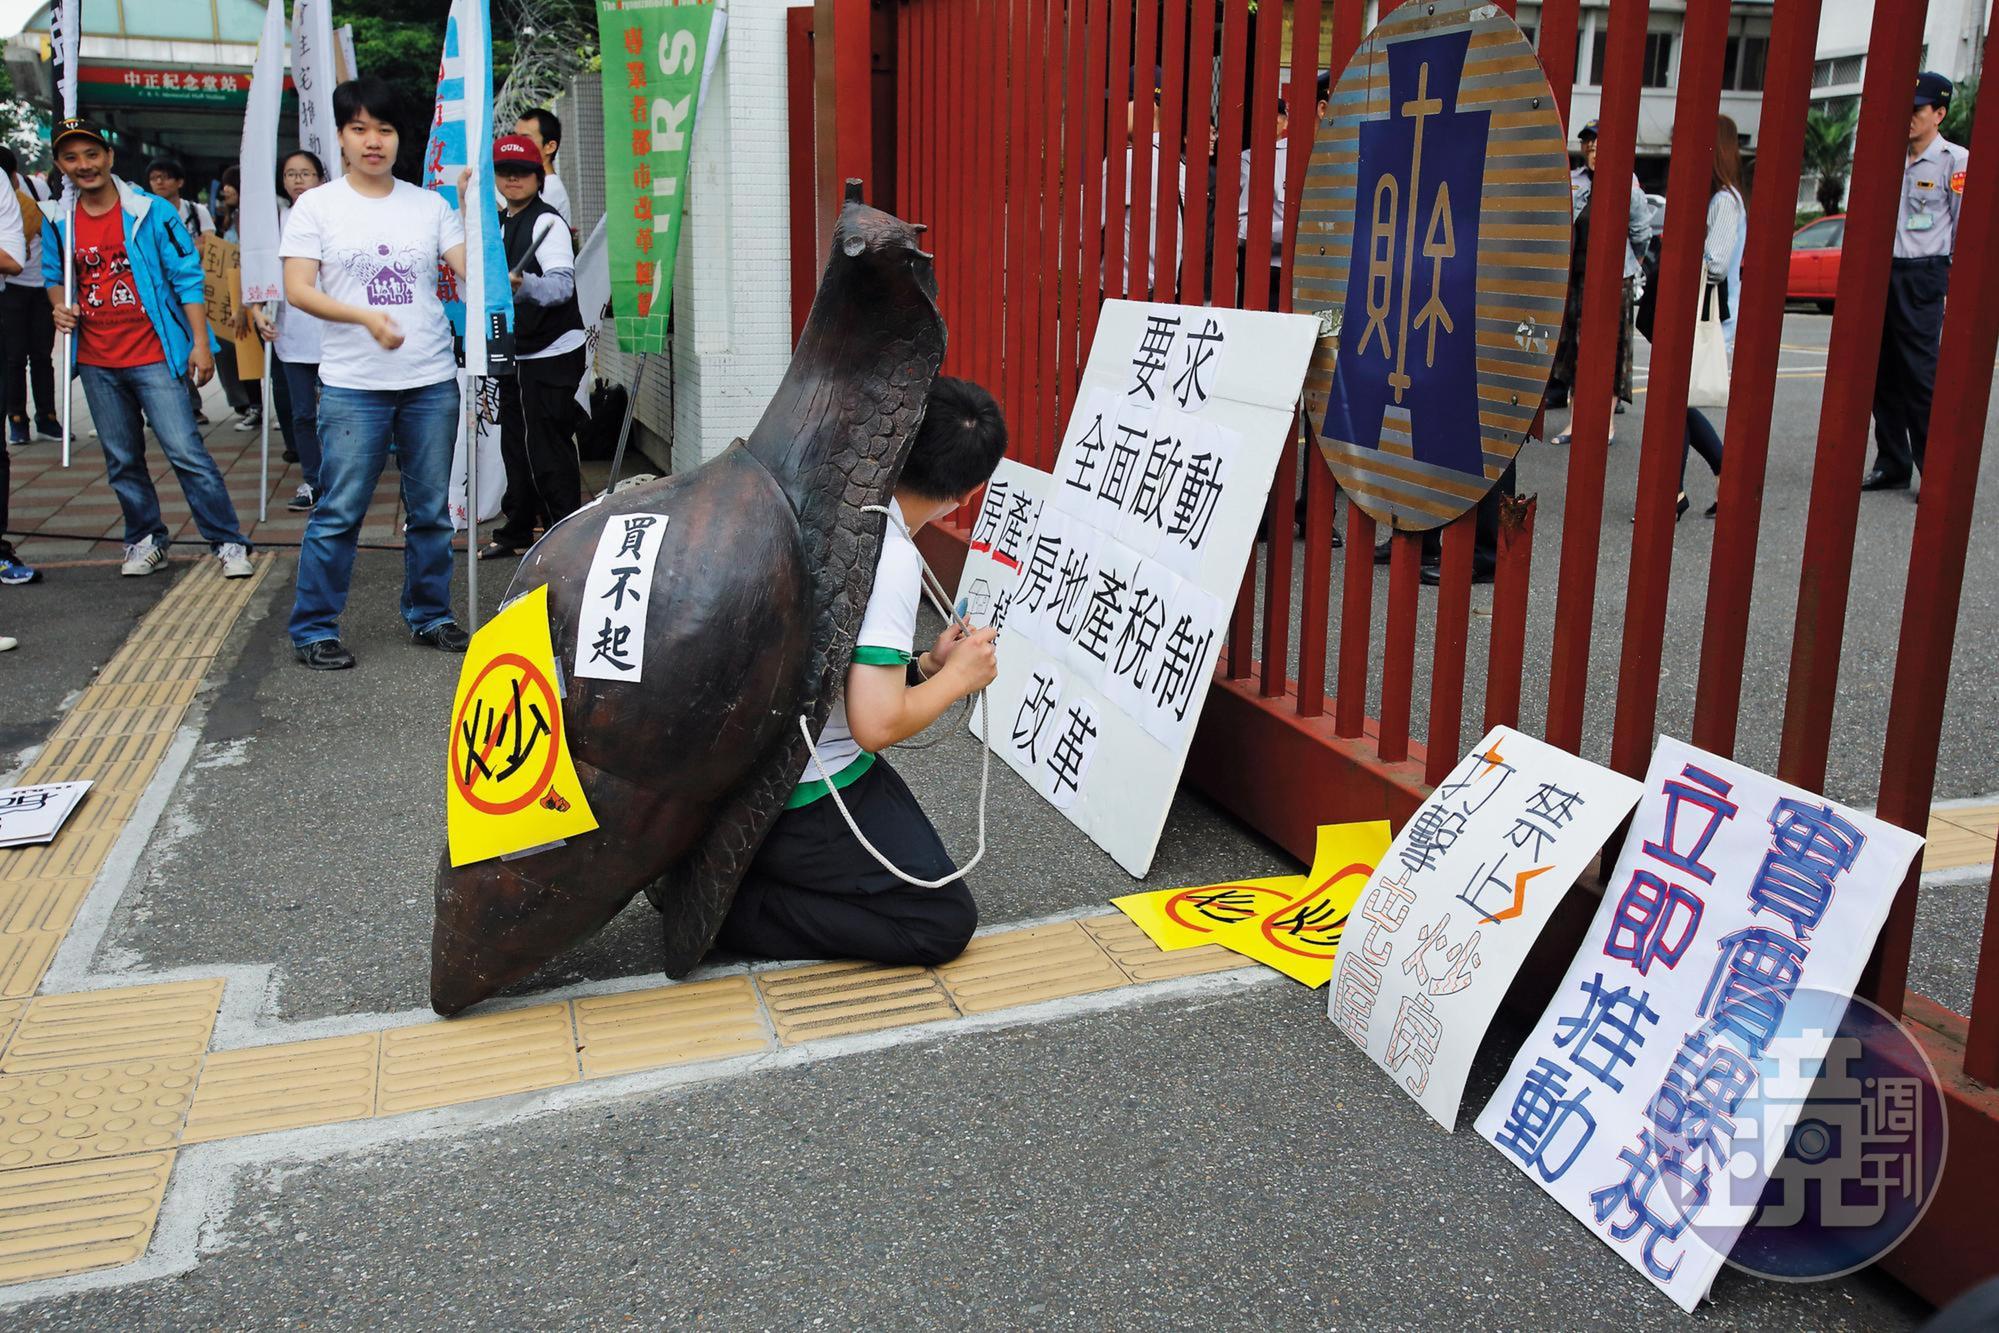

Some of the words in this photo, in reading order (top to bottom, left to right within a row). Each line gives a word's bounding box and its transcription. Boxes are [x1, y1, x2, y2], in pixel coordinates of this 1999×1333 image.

[124, 71, 238, 93] 中正紀念堂站
[1128, 314, 1225, 409] 要求
[1065, 413, 1224, 551] 全面啟動
[589, 515, 658, 672] 買不起
[1010, 533, 1215, 722] 房地產稅制
[462, 678, 552, 786] 炒
[1011, 672, 1098, 794] 改革
[1494, 762, 1739, 1183] 立即推動
